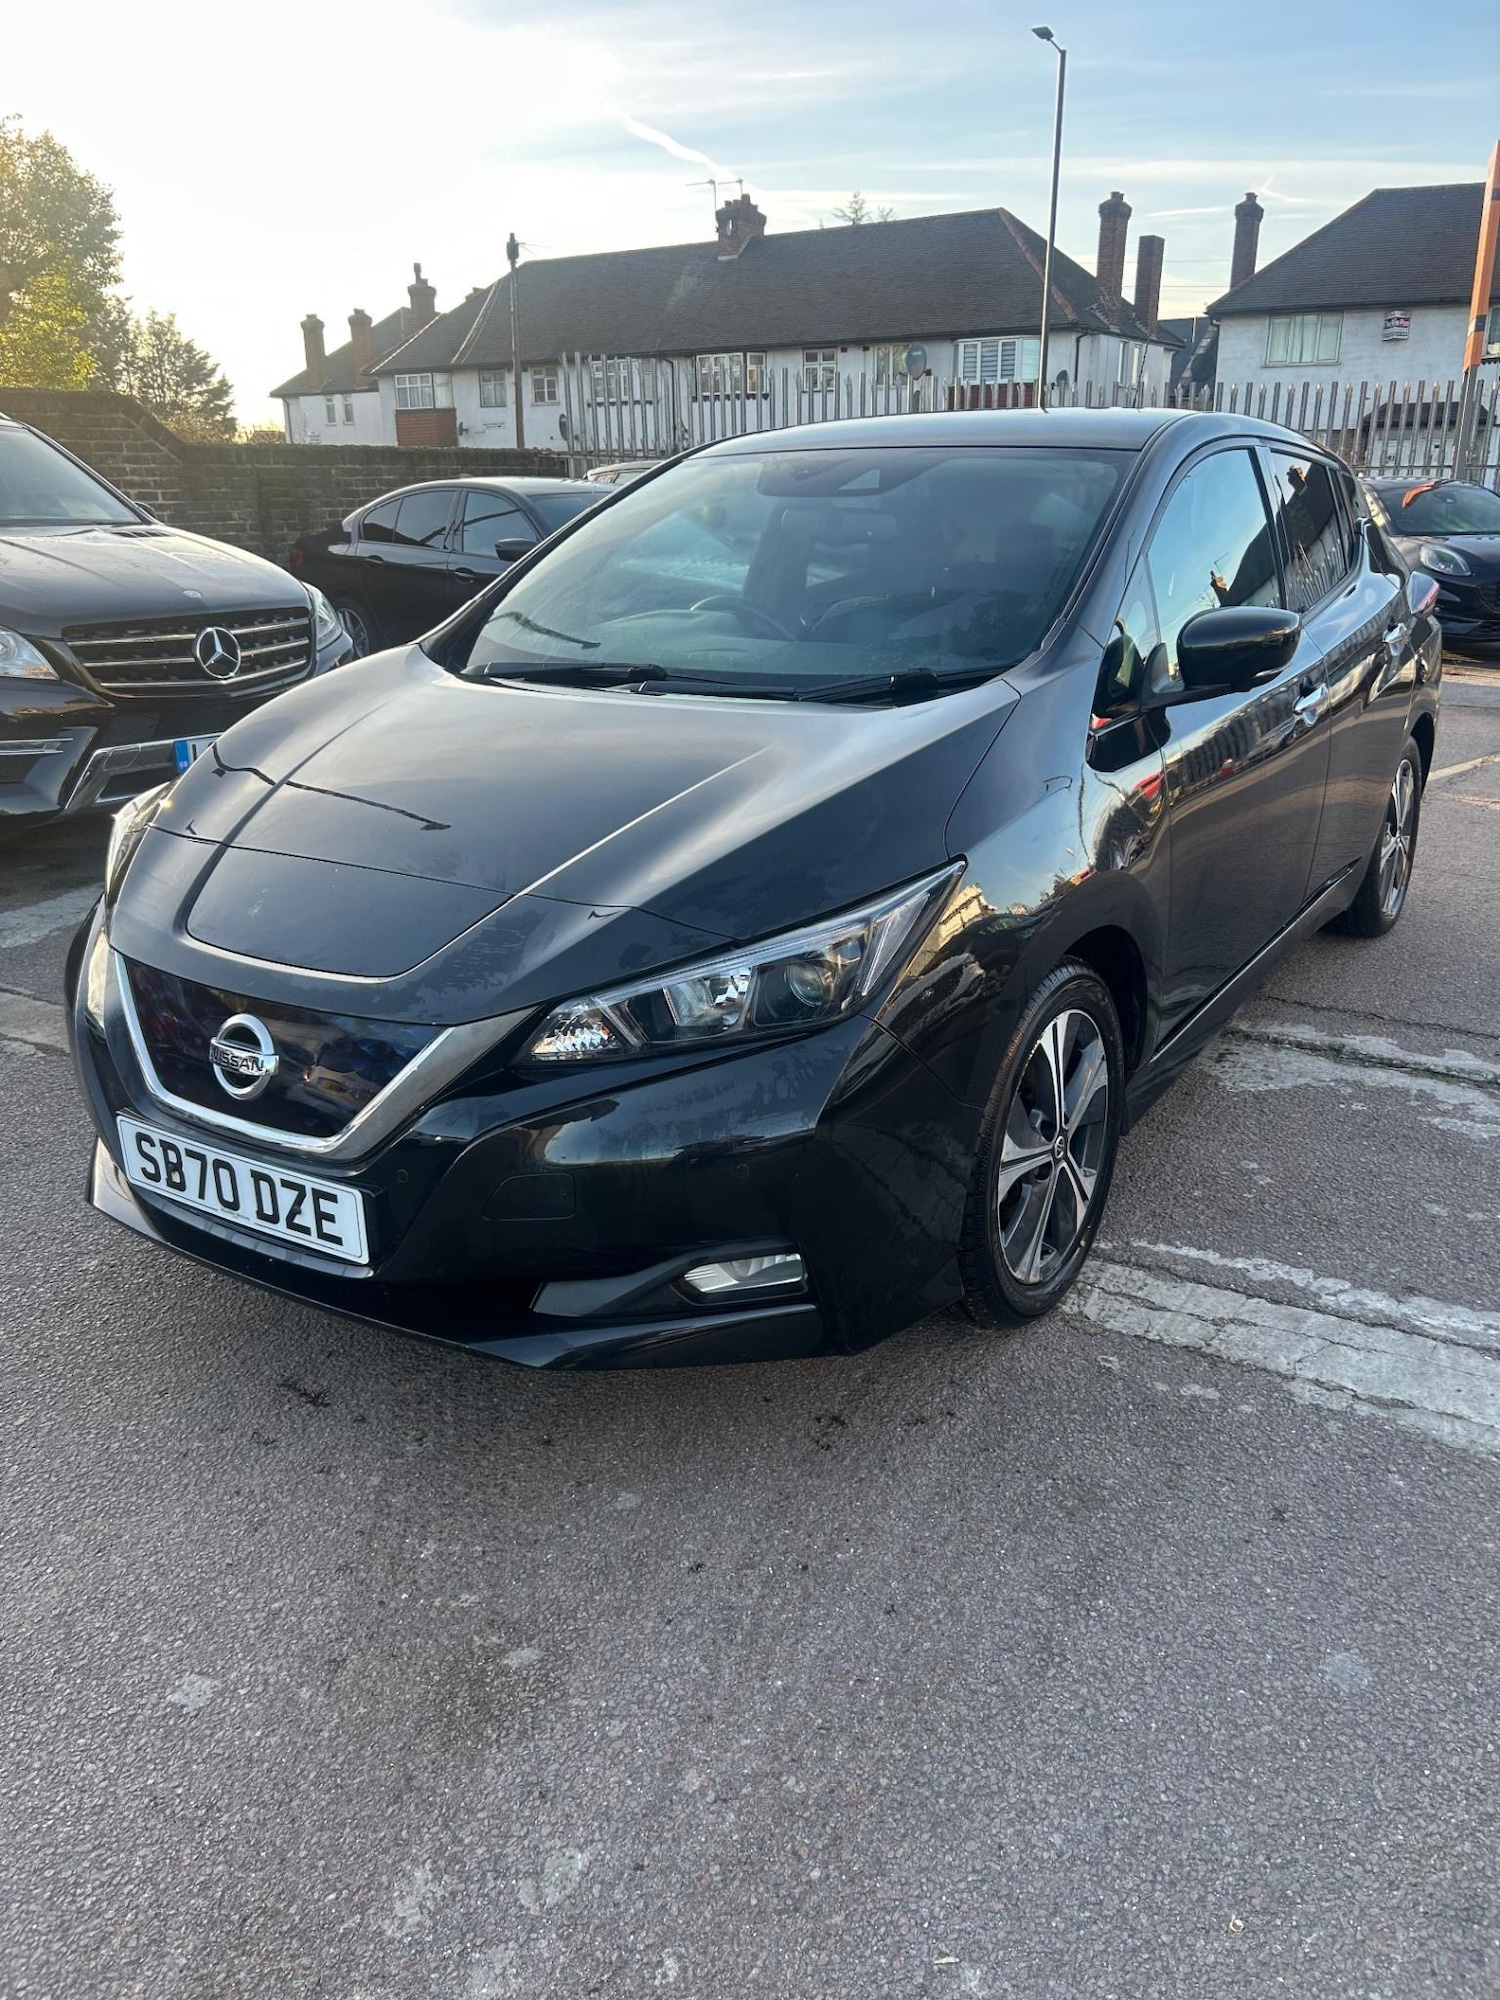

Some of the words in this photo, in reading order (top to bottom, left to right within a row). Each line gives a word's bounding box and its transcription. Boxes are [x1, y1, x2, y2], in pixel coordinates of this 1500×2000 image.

[211, 1046, 265, 1072] NISSAN
[135, 1132, 240, 1211] SB70
[250, 1169, 343, 1247] DZE
